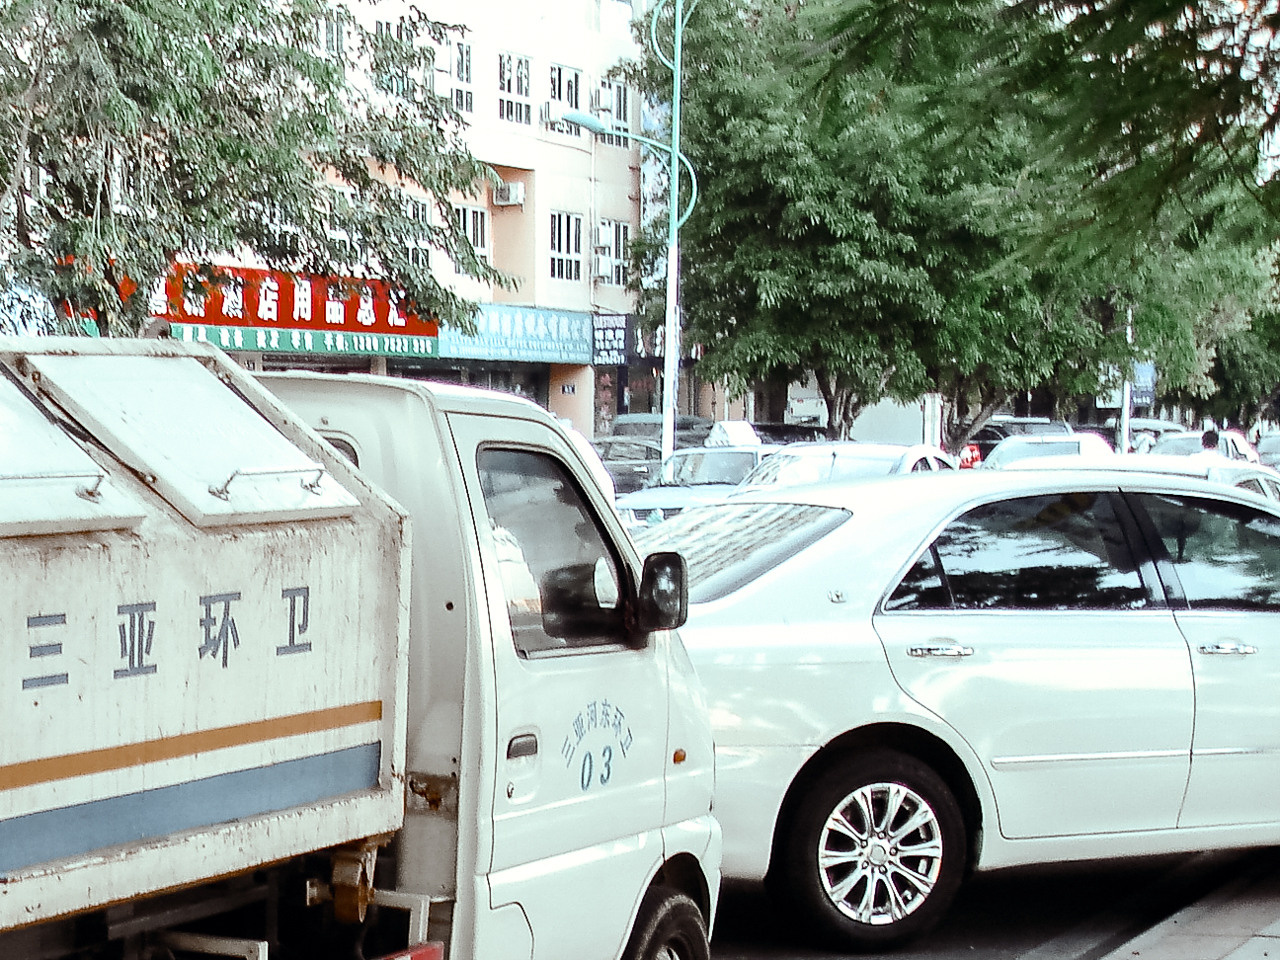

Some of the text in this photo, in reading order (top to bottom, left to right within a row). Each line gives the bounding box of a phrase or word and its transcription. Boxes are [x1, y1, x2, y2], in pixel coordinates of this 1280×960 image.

[21, 585, 313, 691] 三亚环卫
[580, 745, 613, 791] 03
